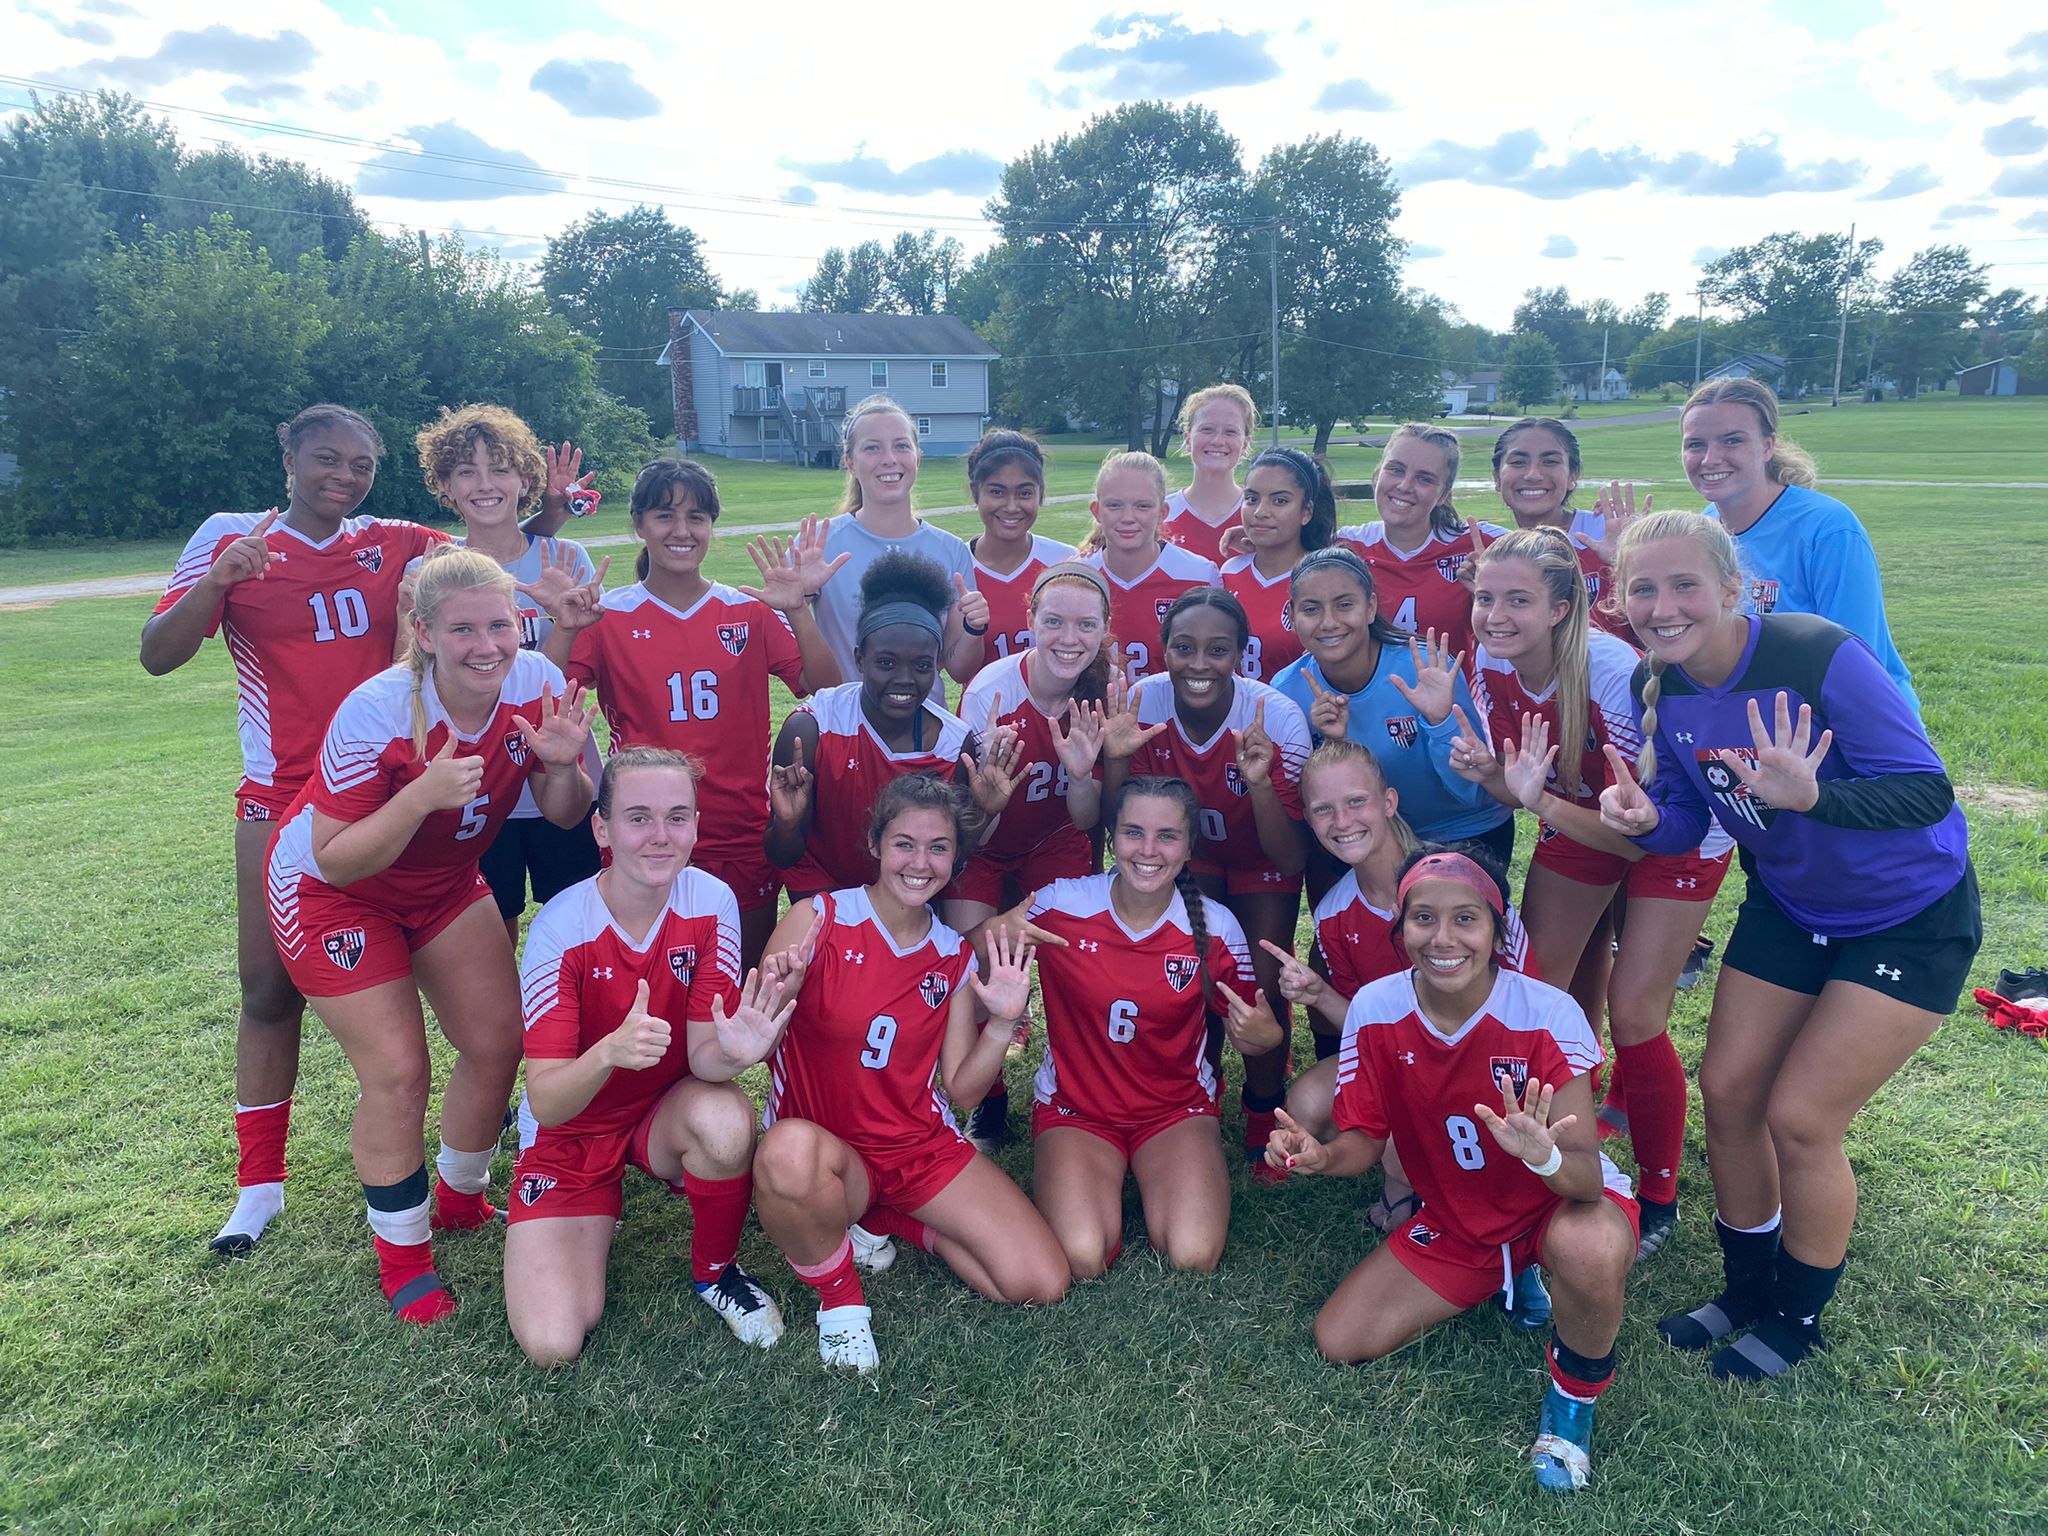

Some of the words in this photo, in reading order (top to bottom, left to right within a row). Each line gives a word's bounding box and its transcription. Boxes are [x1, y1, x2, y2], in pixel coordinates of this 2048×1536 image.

[308, 588, 370, 643] 10
[1391, 595, 1418, 636] 4
[666, 669, 720, 722] 16
[454, 792, 490, 842] 5
[859, 1013, 898, 1070] 9
[1107, 998, 1139, 1044] 6
[1444, 1114, 1486, 1172] 8
